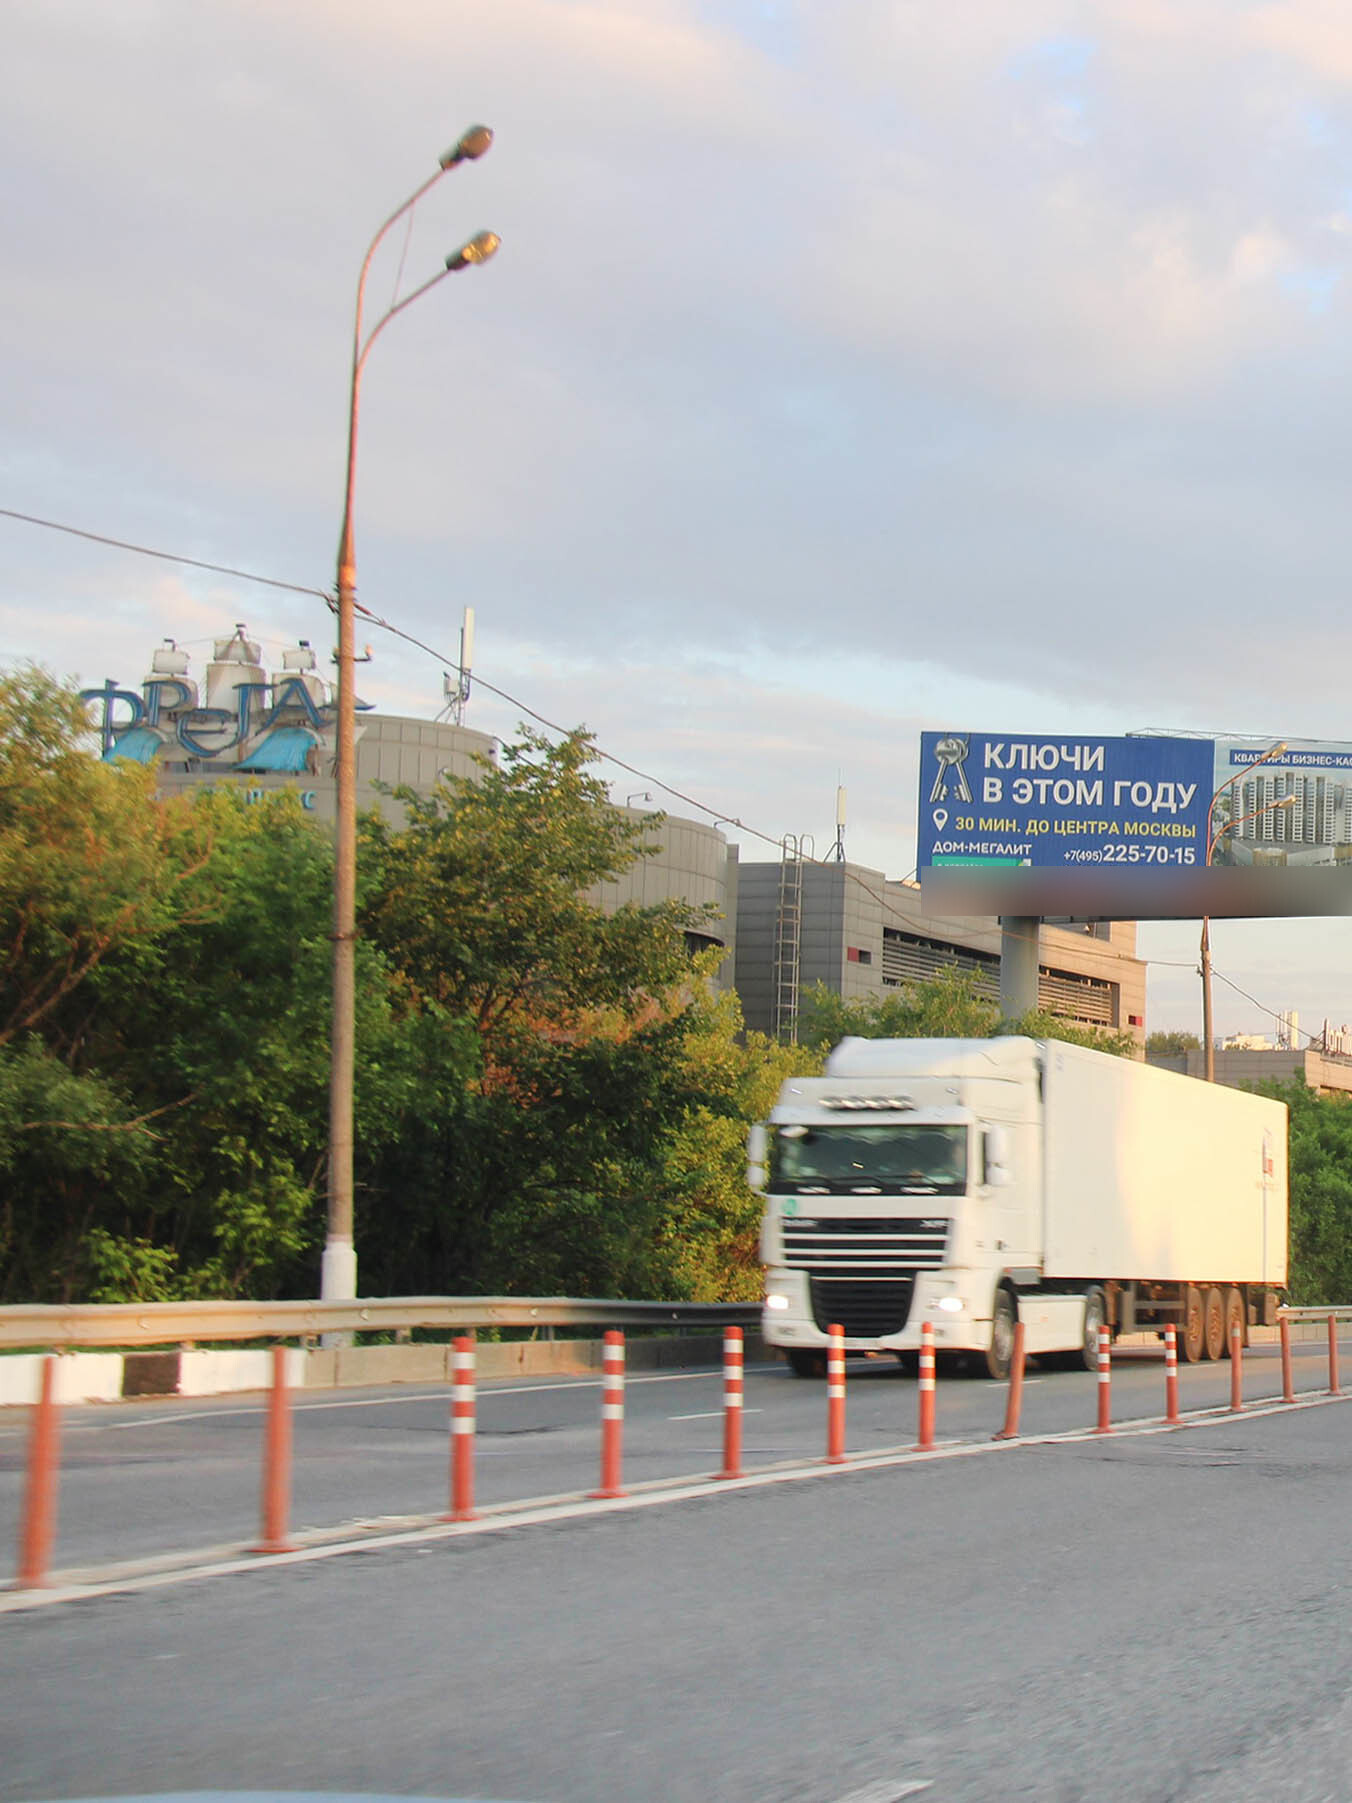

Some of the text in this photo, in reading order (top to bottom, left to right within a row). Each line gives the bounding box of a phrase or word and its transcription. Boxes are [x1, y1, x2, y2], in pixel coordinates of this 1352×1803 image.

[984, 742, 1105, 772] КЛЮЧИ
[1234, 752, 1290, 765] КВАРИРЫ
[983, 776, 1197, 814] В ЭТОМ ГОДУ
[955, 816, 1196, 839] 30 МИН. ДО ЦЕНТРА МОСКВЫ
